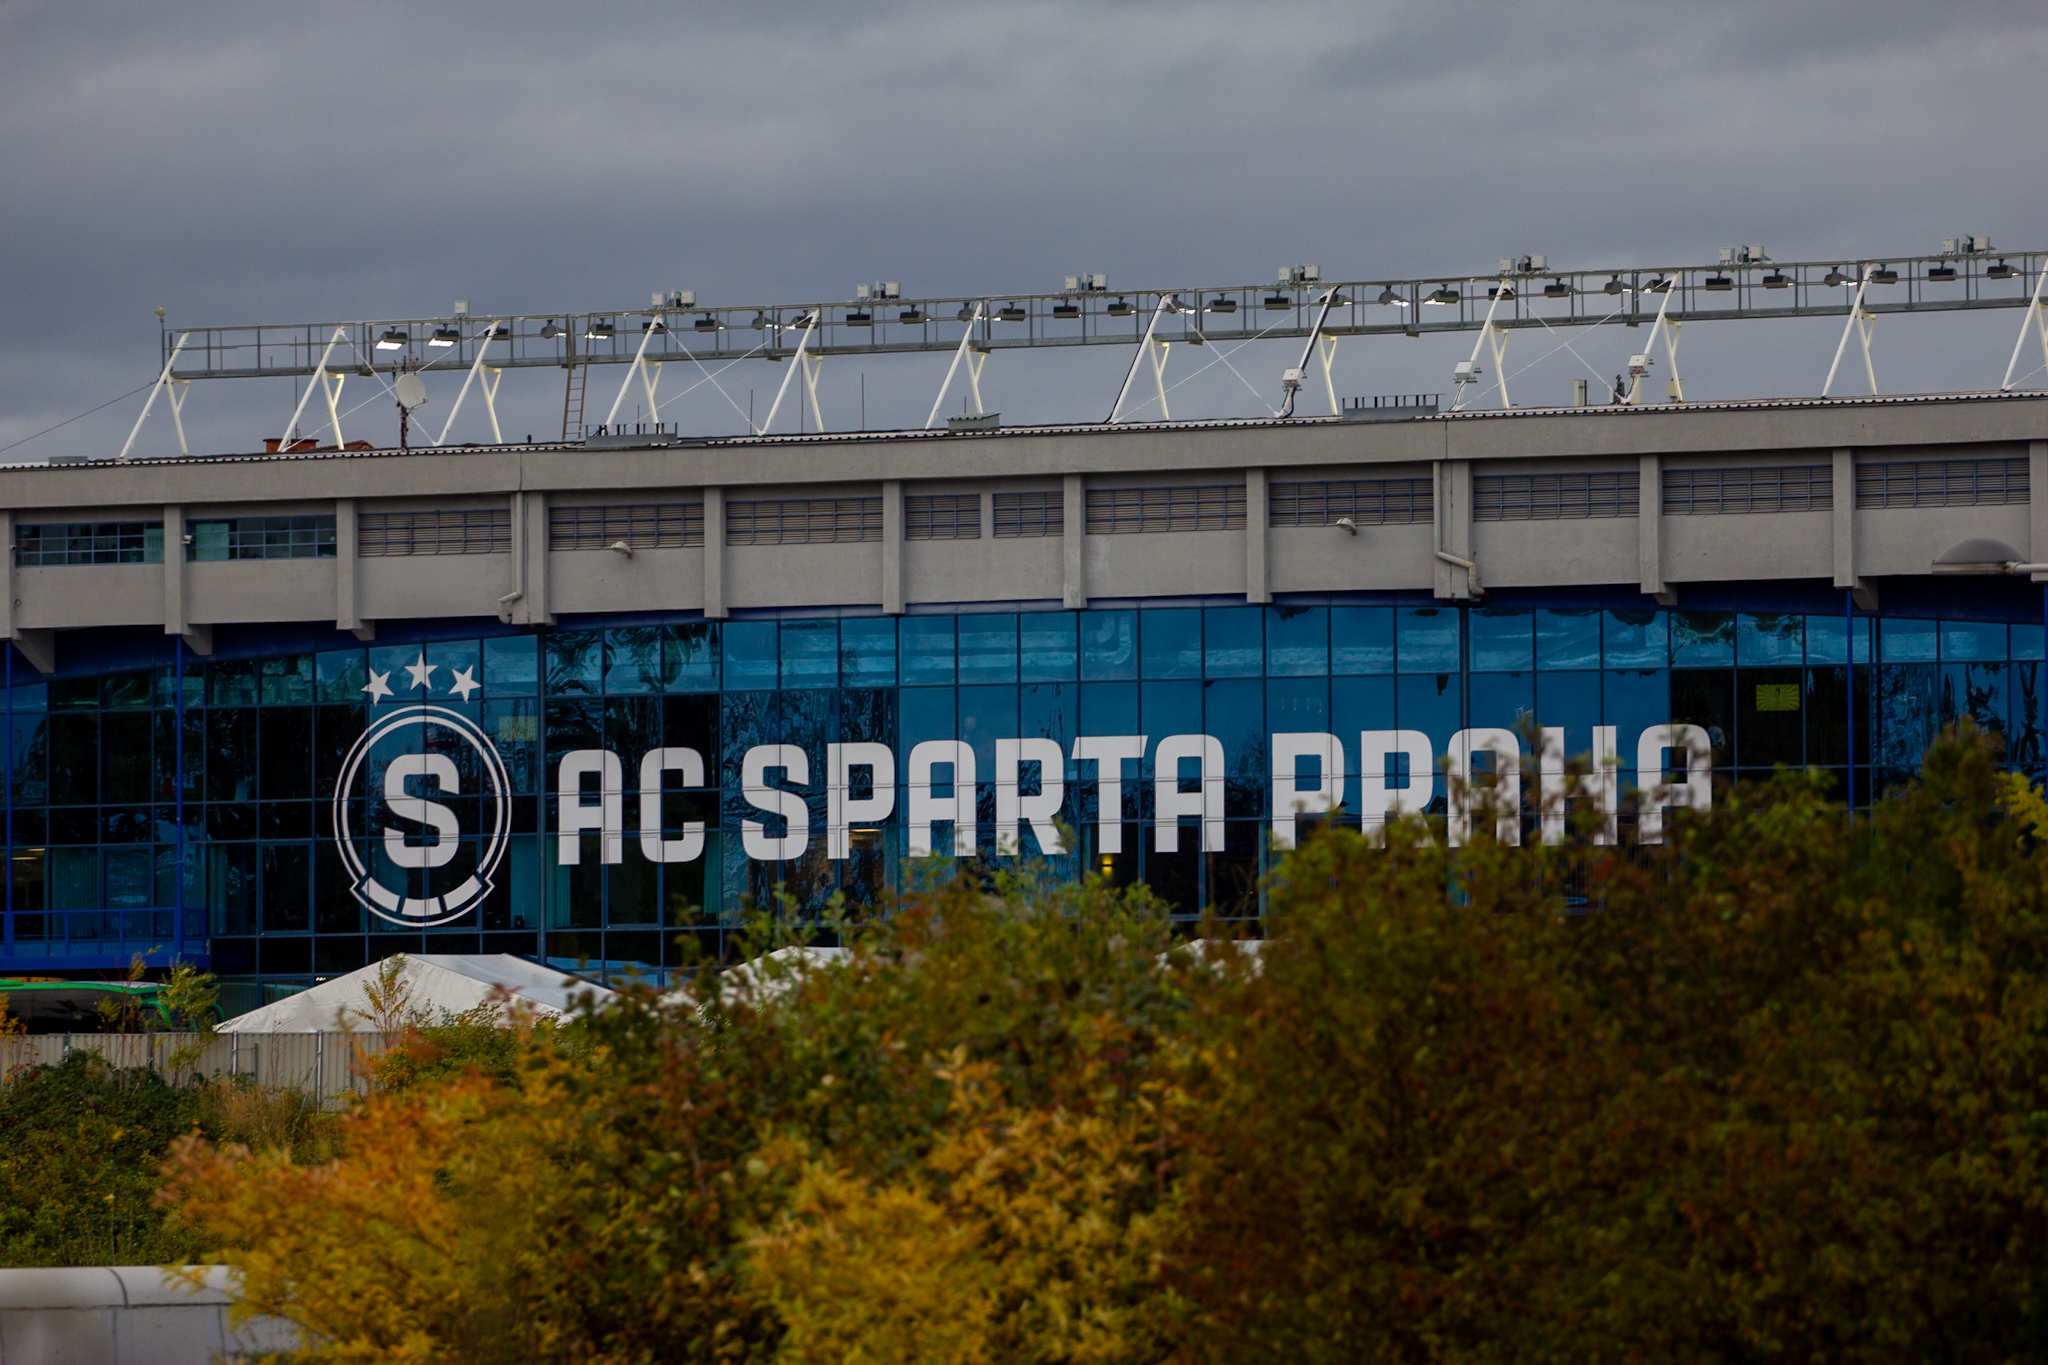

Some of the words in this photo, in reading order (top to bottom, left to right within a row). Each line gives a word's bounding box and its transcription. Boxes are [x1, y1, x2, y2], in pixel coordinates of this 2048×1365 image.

[384, 753, 460, 867] S
[558, 747, 705, 865] AC
[742, 734, 1225, 860] SPARTA
[1272, 724, 1712, 850] PRAHA
